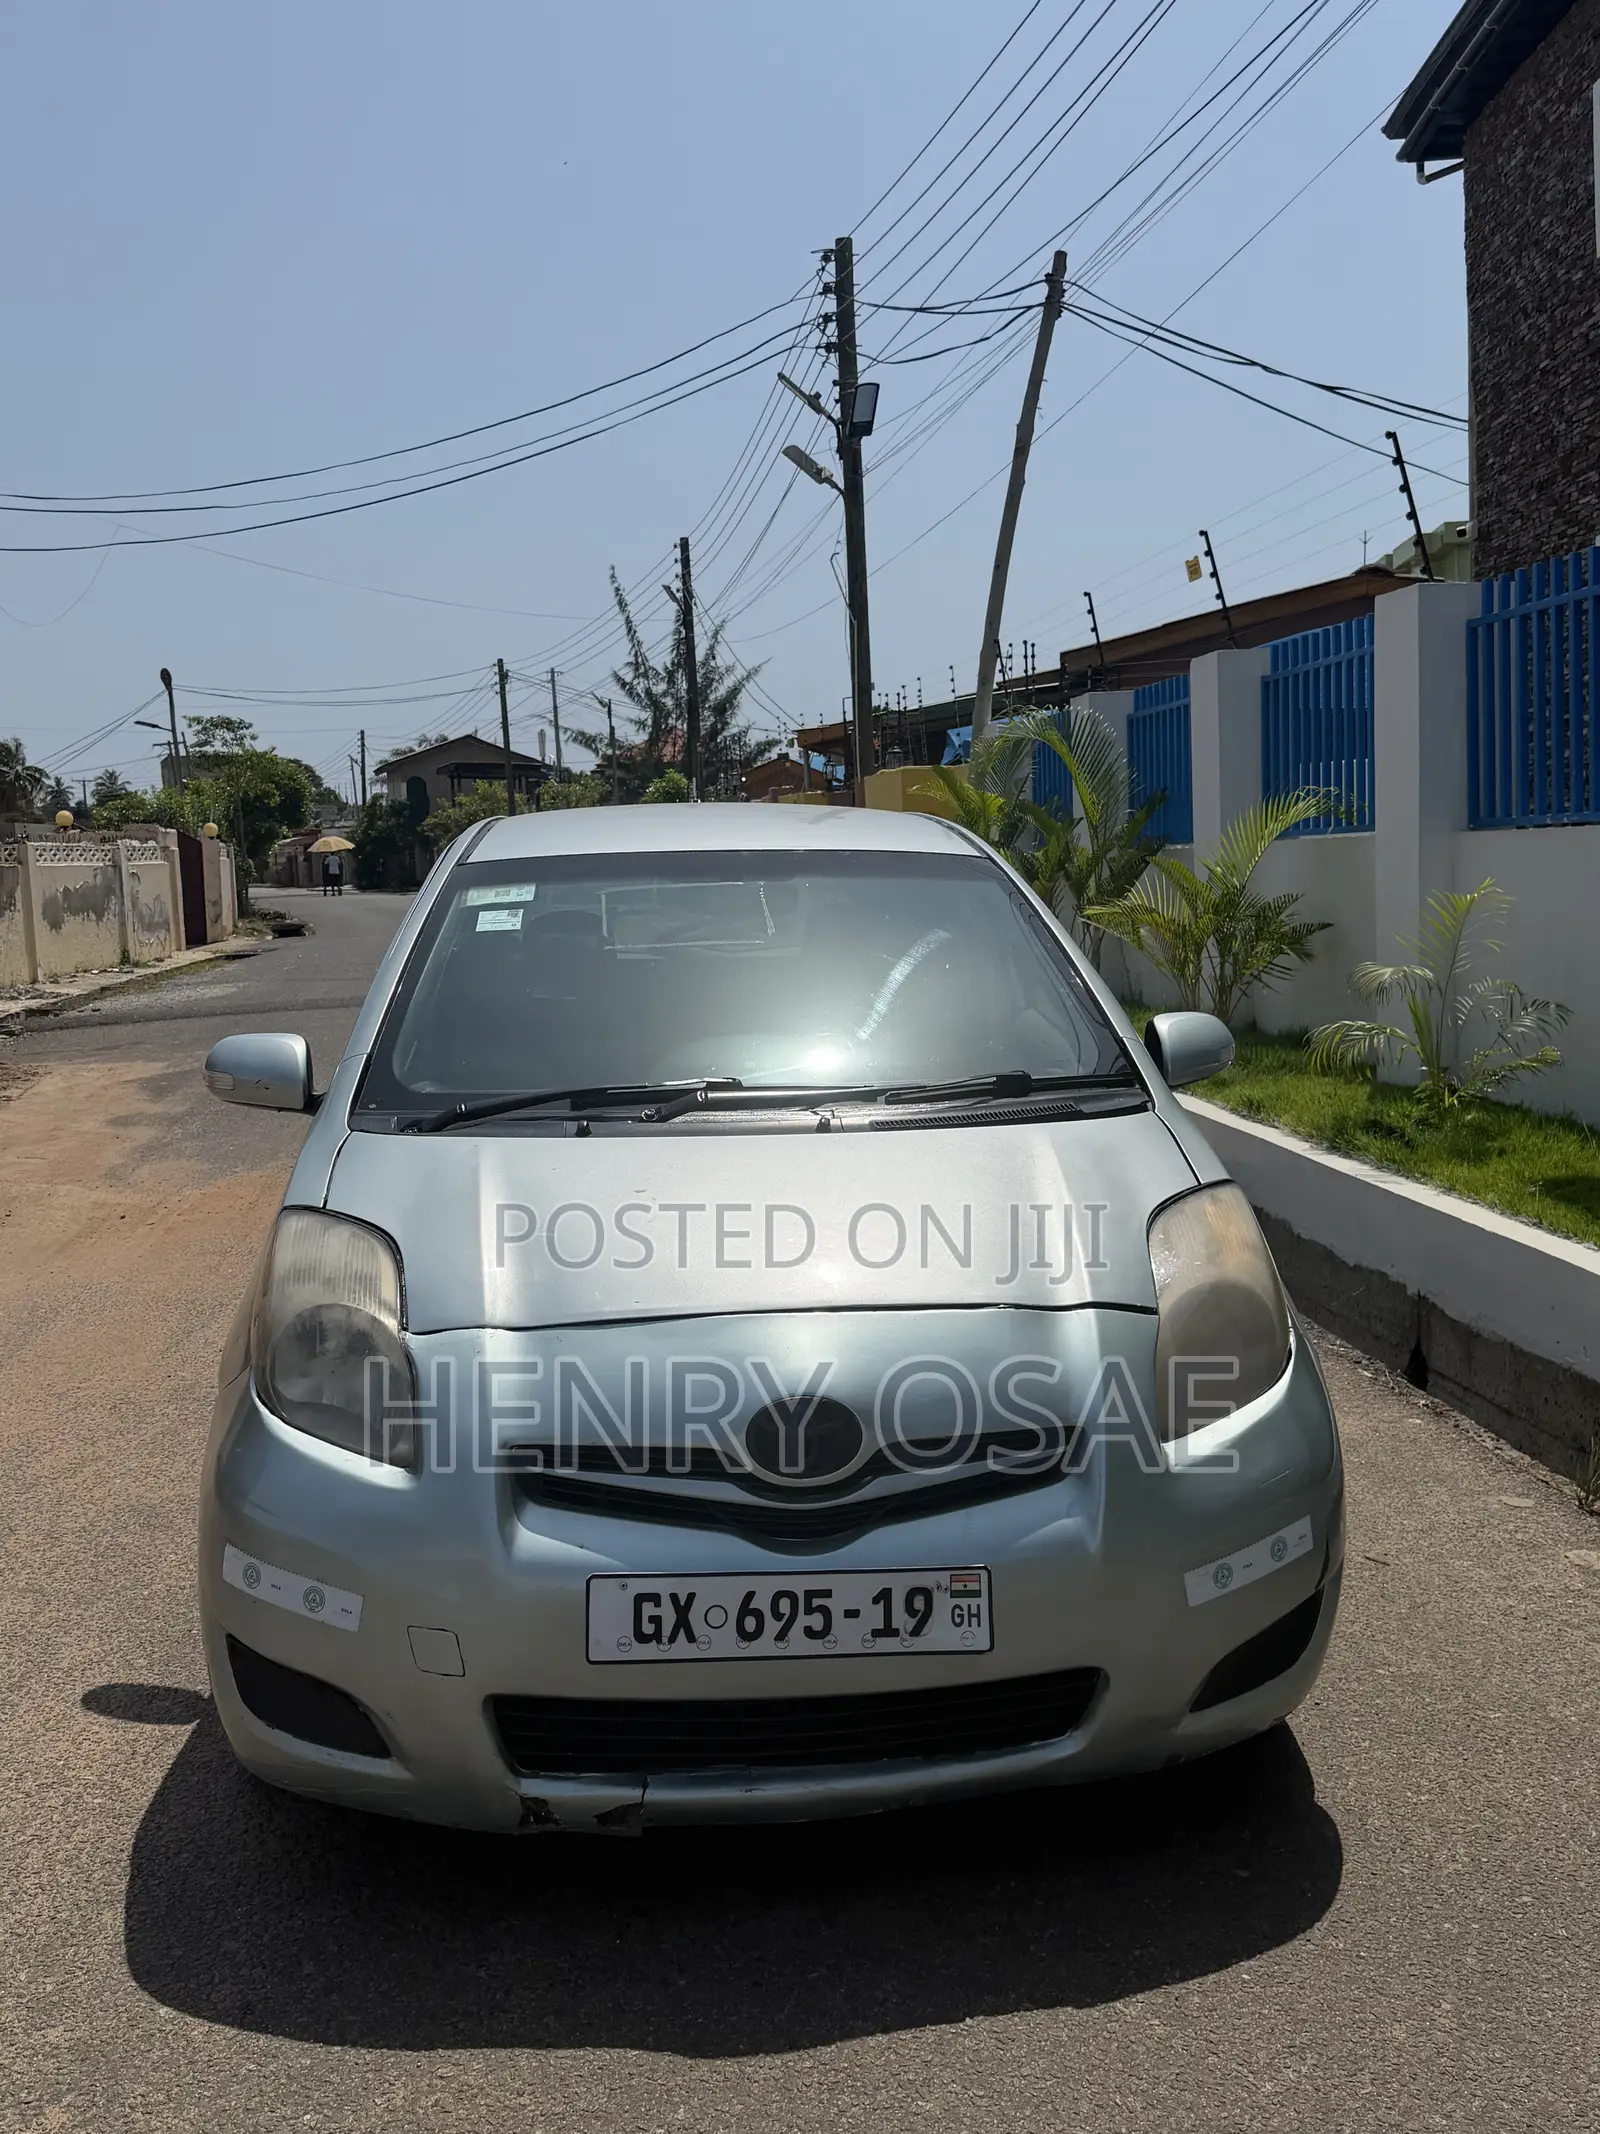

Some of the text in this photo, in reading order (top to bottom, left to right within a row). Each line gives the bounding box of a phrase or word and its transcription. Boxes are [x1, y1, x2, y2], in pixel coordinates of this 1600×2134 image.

[633, 1586, 934, 1644] GX 695-19
[951, 1603, 981, 1628] GH
